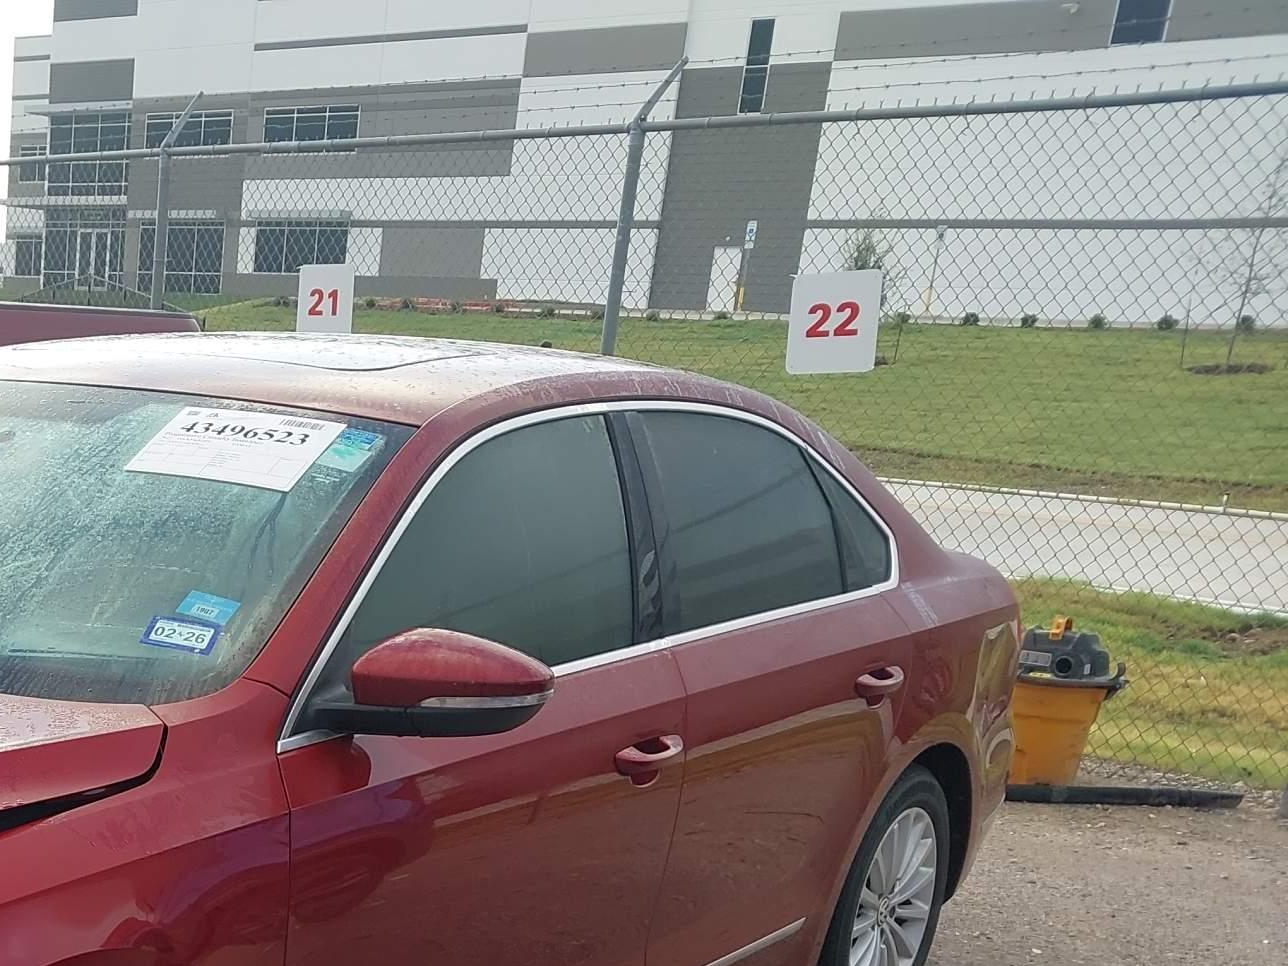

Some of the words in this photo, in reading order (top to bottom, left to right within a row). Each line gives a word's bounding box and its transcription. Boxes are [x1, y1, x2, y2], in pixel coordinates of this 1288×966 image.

[308, 288, 339, 316] 21
[805, 301, 861, 338] 22
[180, 420, 311, 446] 43496523
